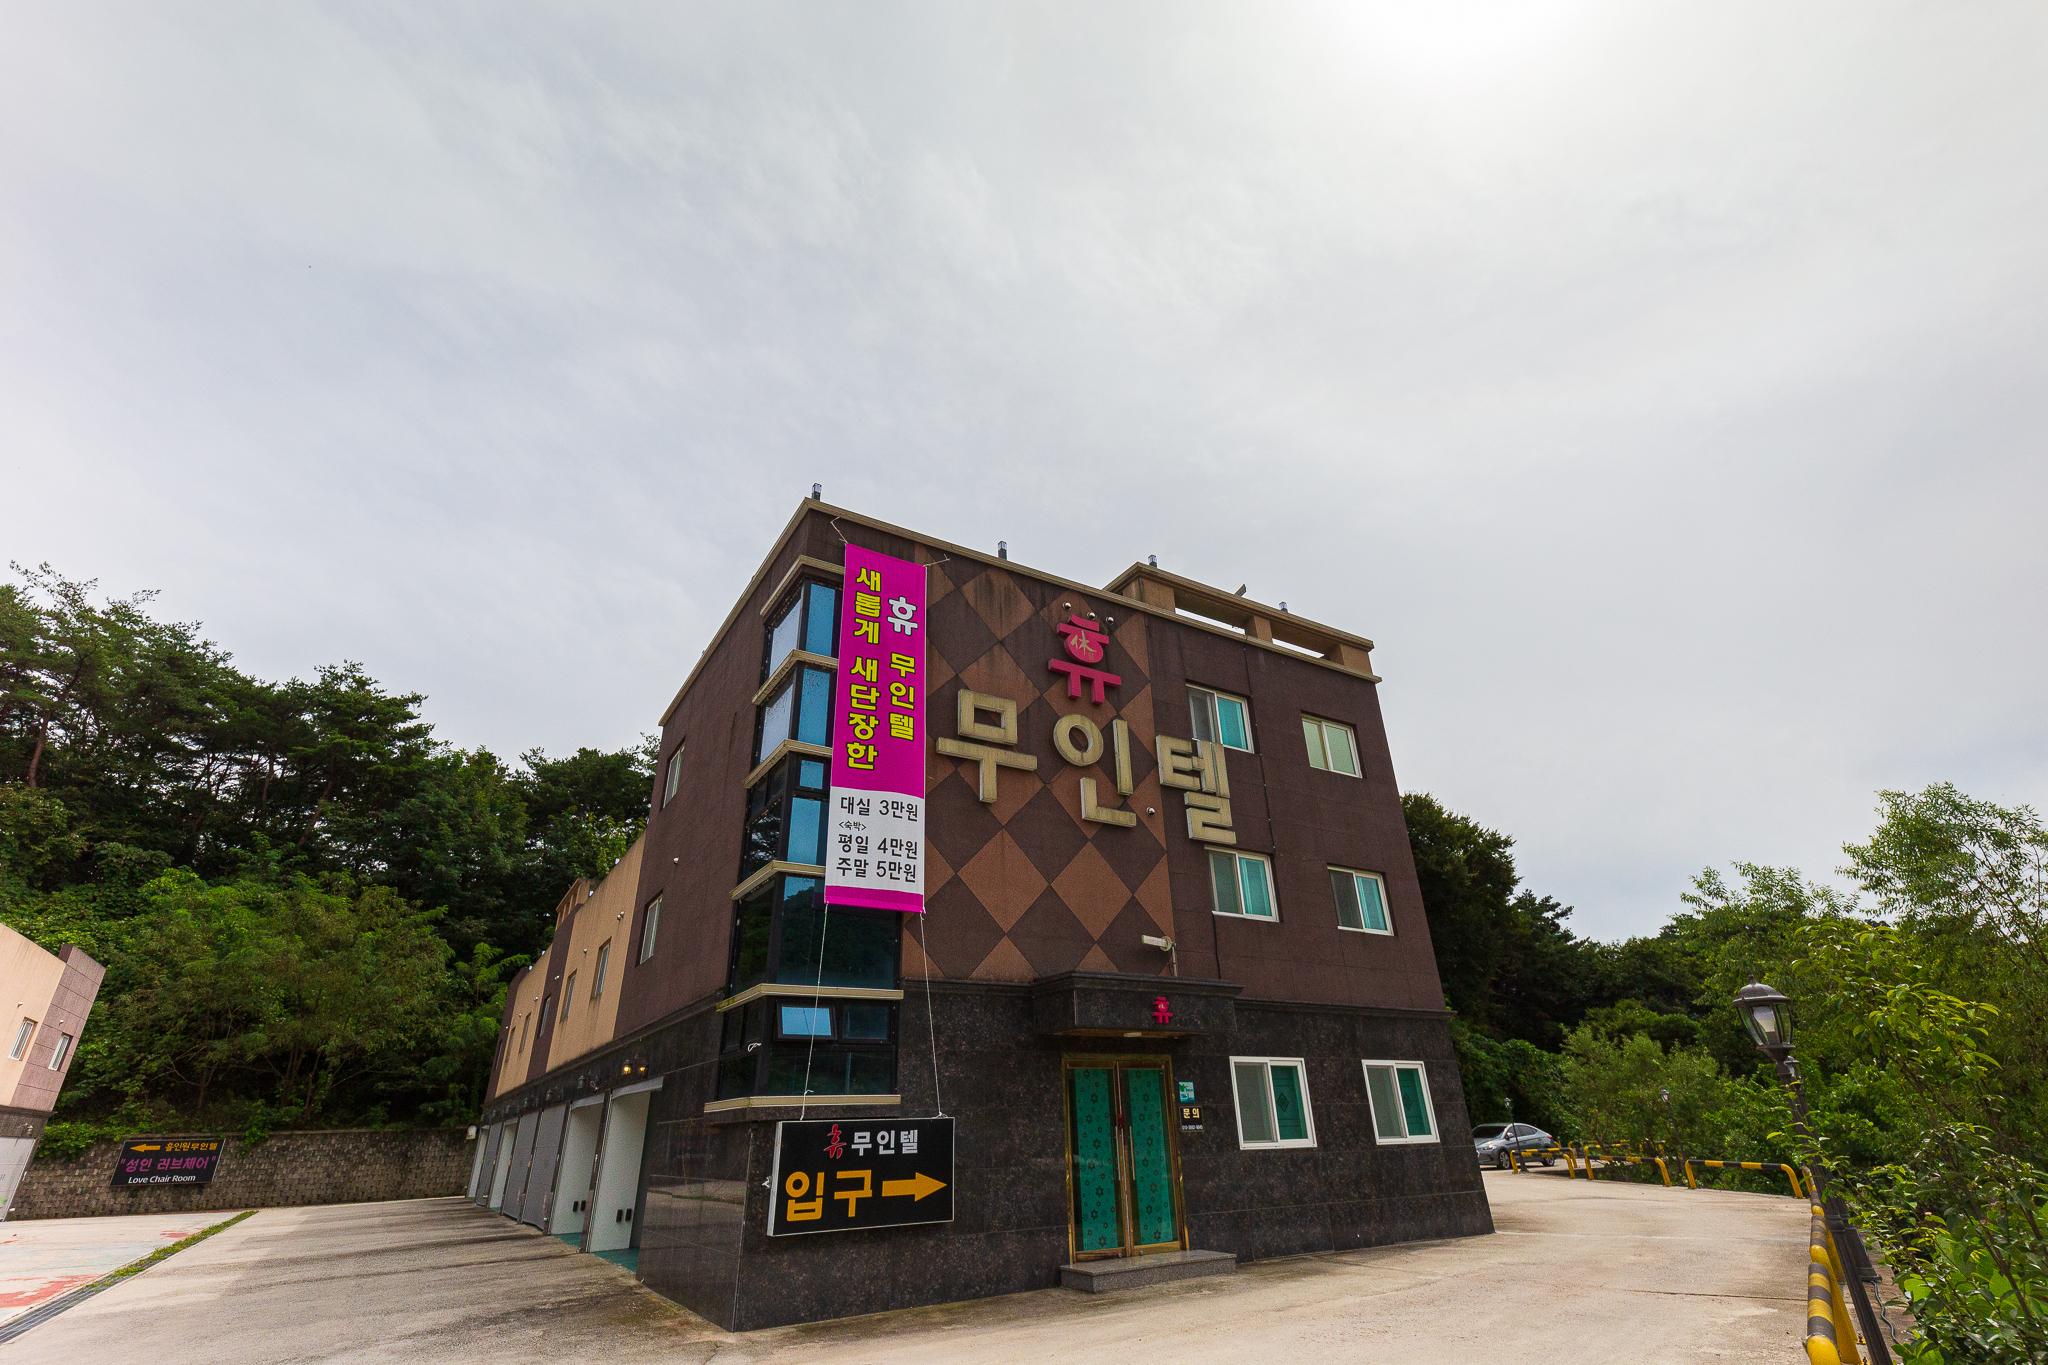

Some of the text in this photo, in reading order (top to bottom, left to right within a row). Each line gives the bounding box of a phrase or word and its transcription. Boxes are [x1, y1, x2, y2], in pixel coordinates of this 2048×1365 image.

[846, 567, 882, 771] 새롭게 새단장한
[887, 596, 918, 742] 휴 무인텔
[1048, 614, 1121, 704] 휴
[936, 688, 1237, 845] 무인텔
[841, 796, 918, 822] 대실 3만원
[838, 833, 917, 860] 평일 4만원
[836, 857, 916, 883] 주말 5만원
[851, 1129, 918, 1156] 무인텔
[128, 1174, 196, 1184] Love Chair Room
[785, 1169, 873, 1222] 입구
